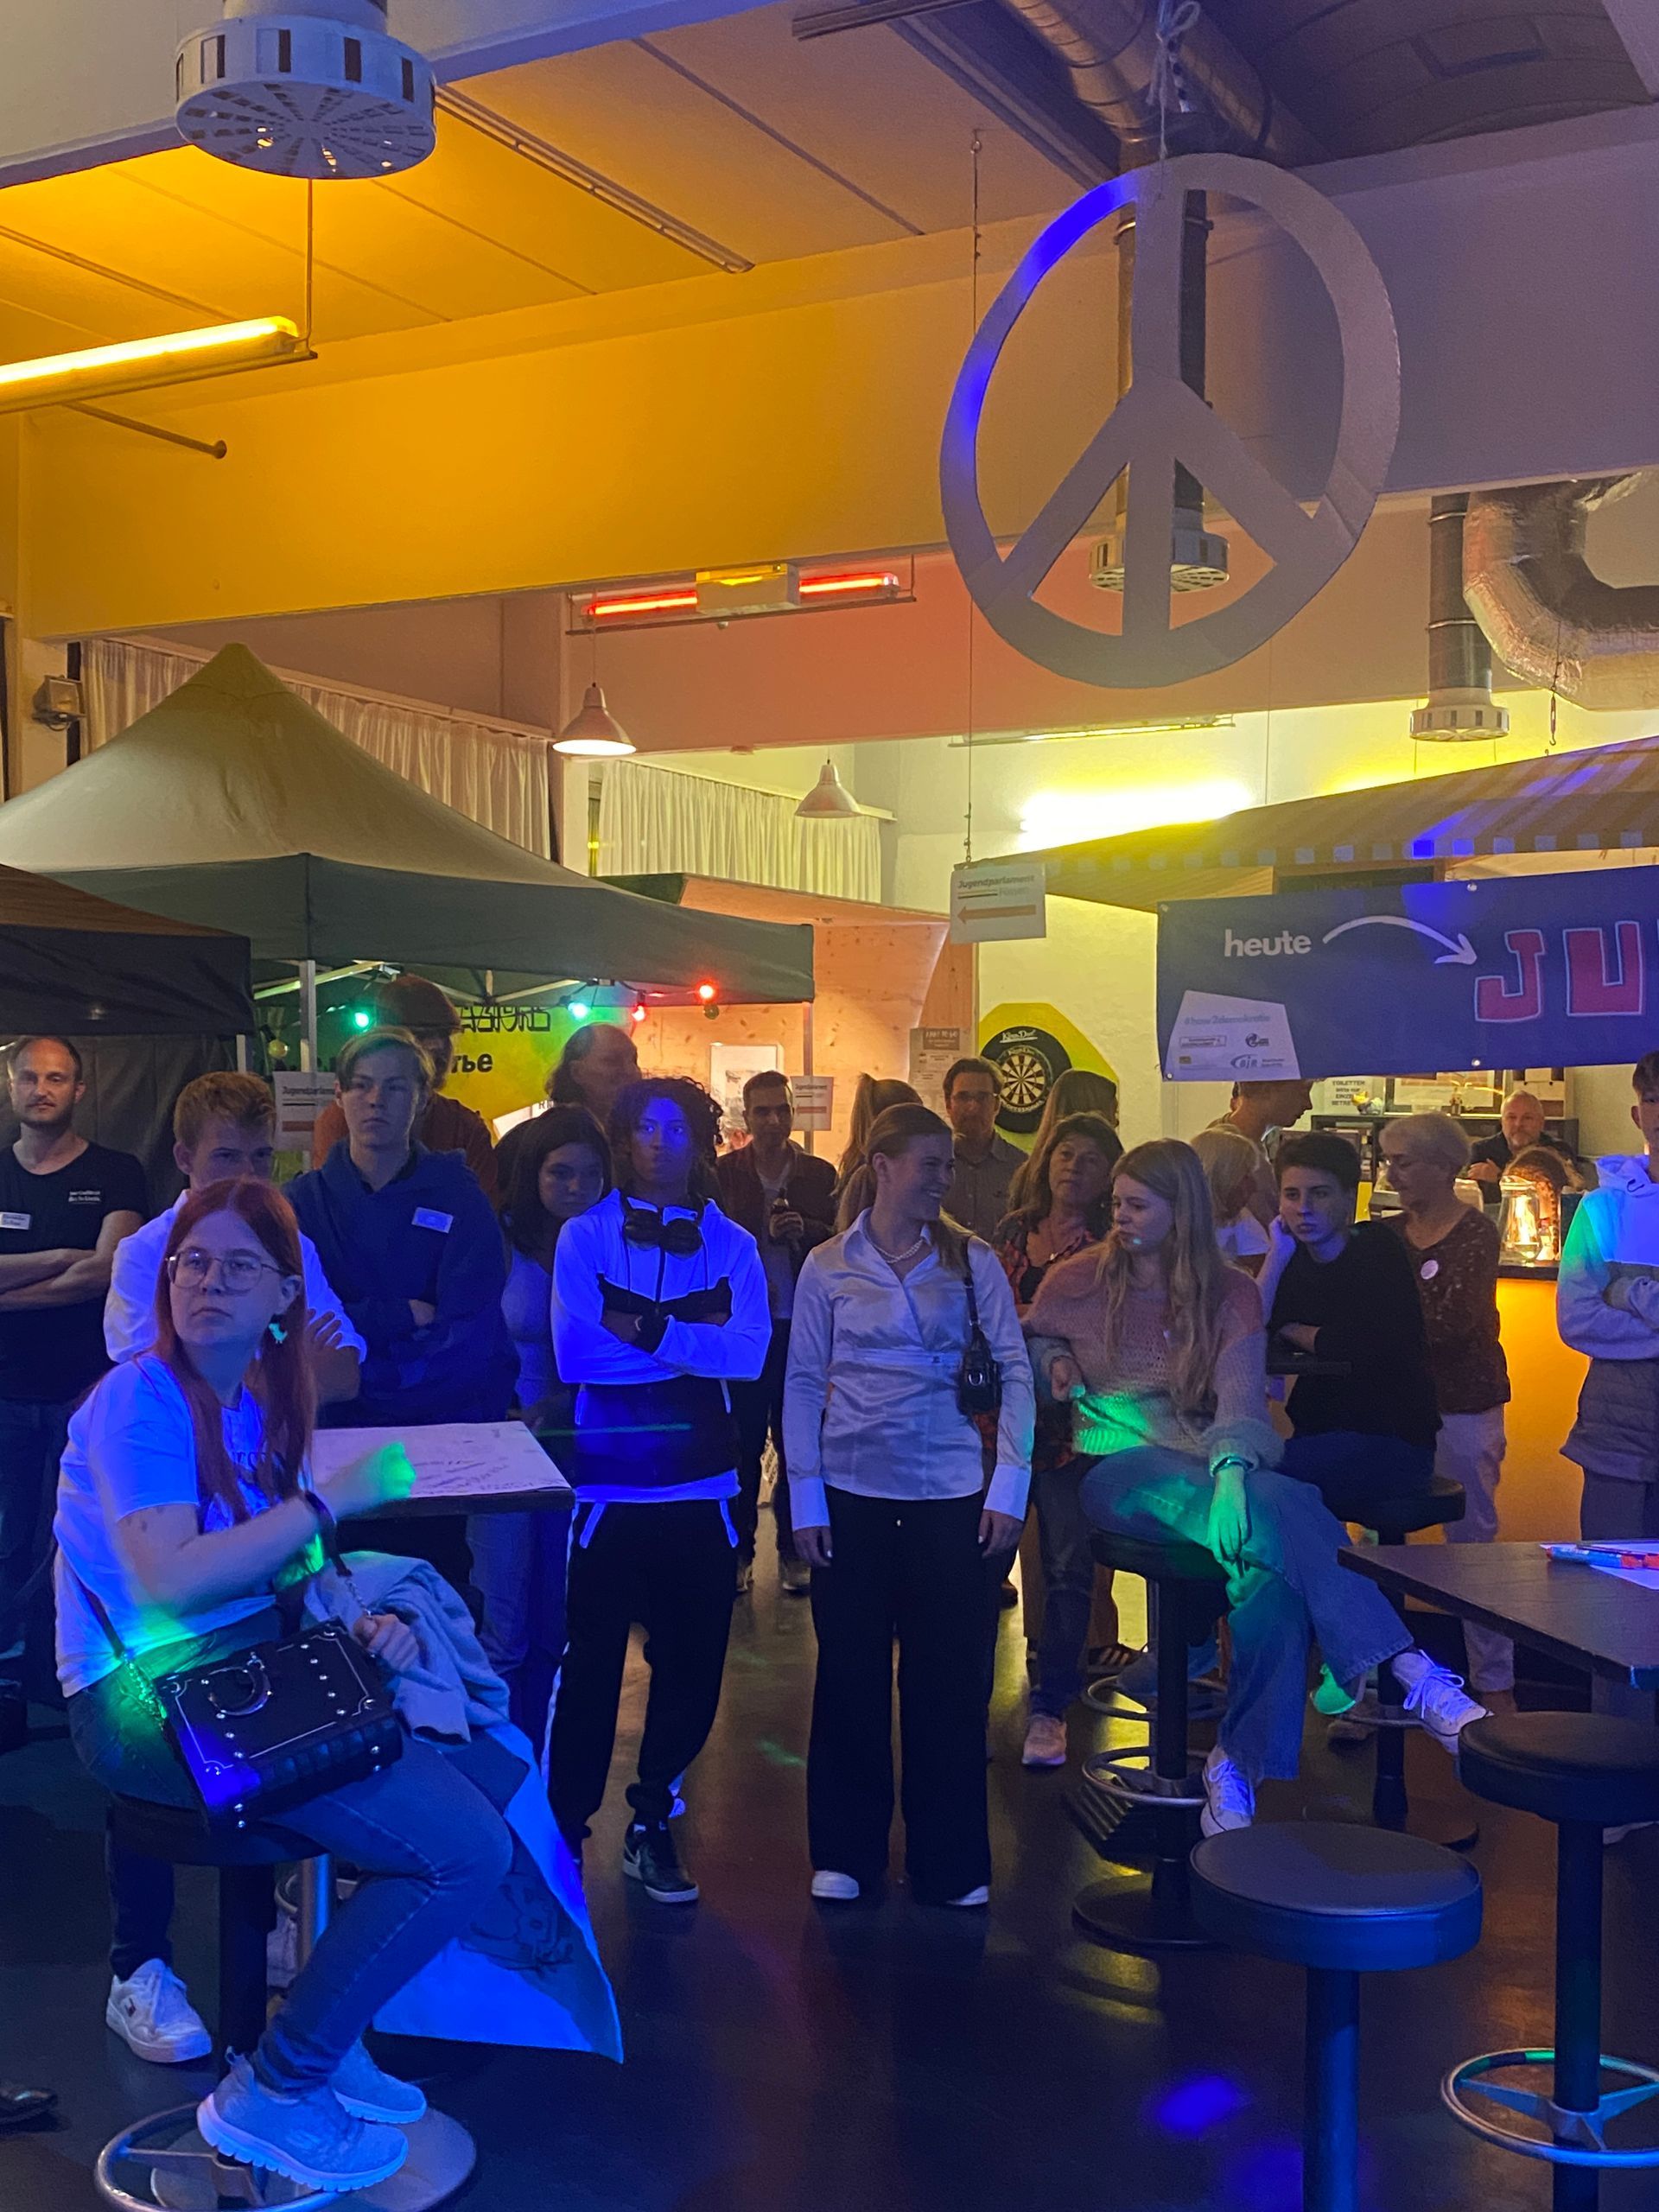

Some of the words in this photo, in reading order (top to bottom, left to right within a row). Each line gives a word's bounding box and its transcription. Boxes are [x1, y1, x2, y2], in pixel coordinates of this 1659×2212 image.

[957, 874, 1035, 889] Jugendparlament
[1224, 929, 1313, 957] heute
[1474, 920, 1659, 1023] JU
